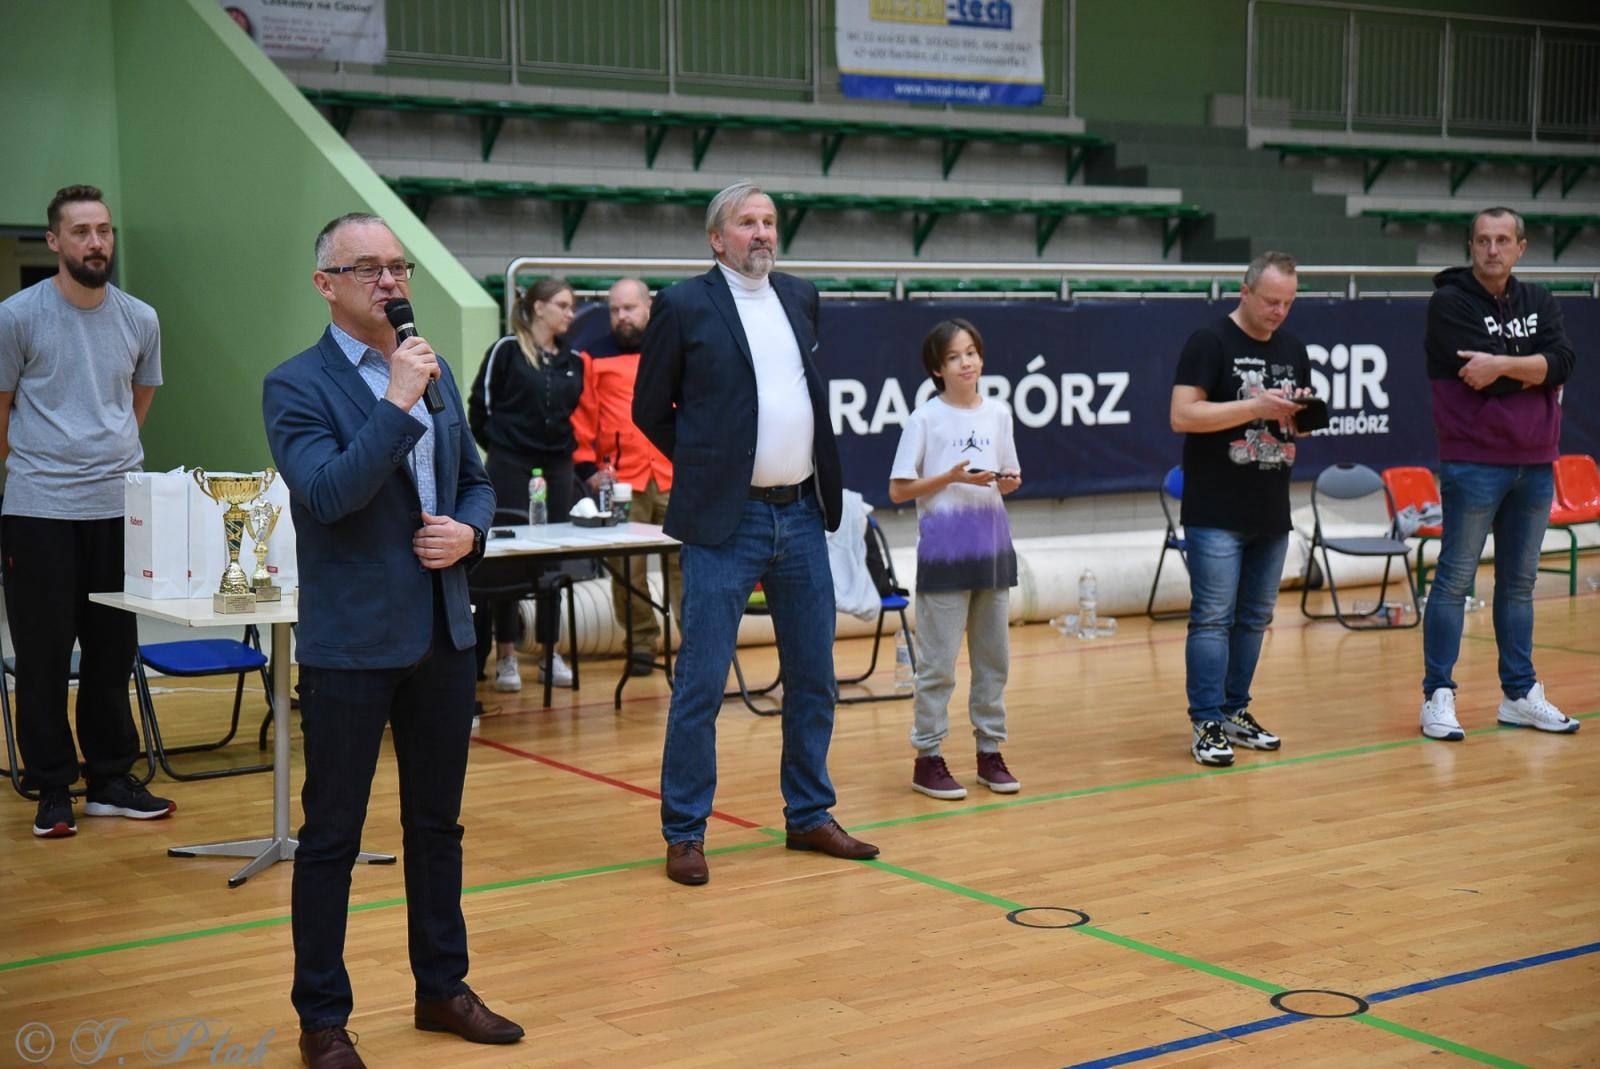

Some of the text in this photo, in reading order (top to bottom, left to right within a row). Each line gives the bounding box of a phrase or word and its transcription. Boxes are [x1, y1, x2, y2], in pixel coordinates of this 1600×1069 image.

[828, 354, 1131, 436] RABÓRZ
[1305, 343, 1390, 410] SiR
[1311, 409, 1390, 437] CIBÓRZ
